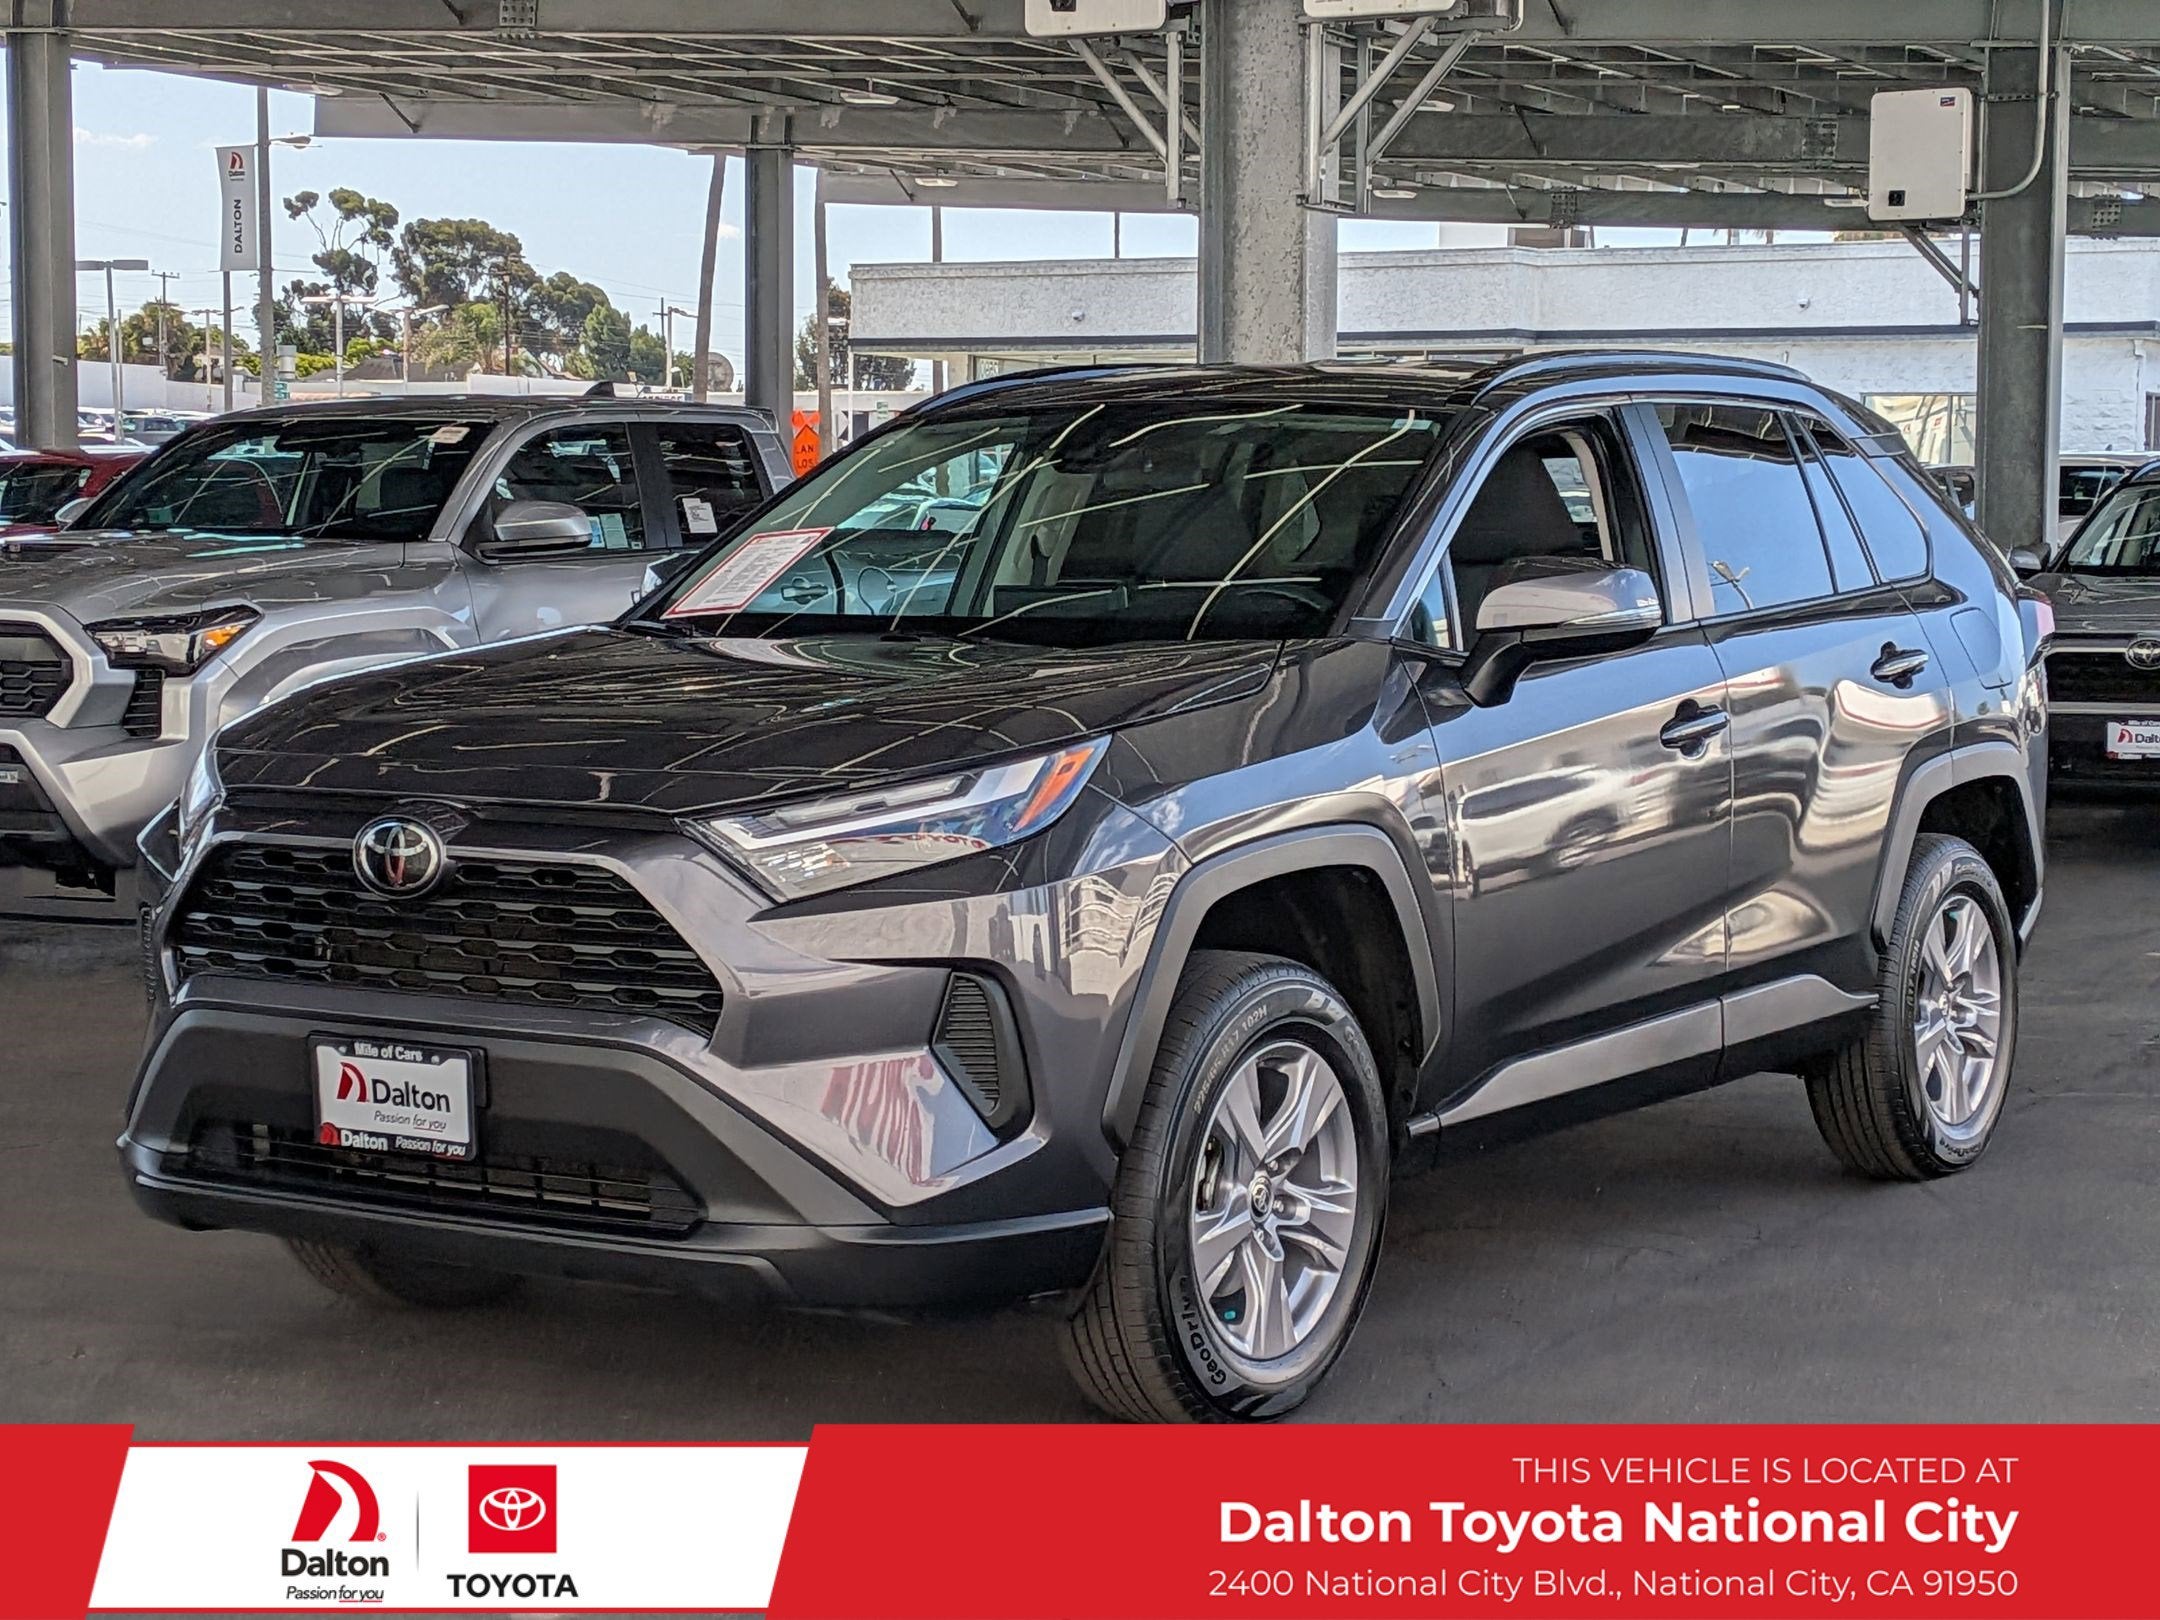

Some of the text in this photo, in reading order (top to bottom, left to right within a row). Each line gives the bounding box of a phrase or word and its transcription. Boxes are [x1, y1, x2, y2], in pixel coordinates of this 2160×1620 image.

[234, 199, 243, 254] DALTON
[1241, 1004, 1268, 1033] 102H
[354, 1042, 423, 1062] Mile of Cars
[371, 1078, 451, 1113] Dalton
[374, 1110, 447, 1131] Passion for you
[340, 1129, 466, 1157] Dalton Passion for you
